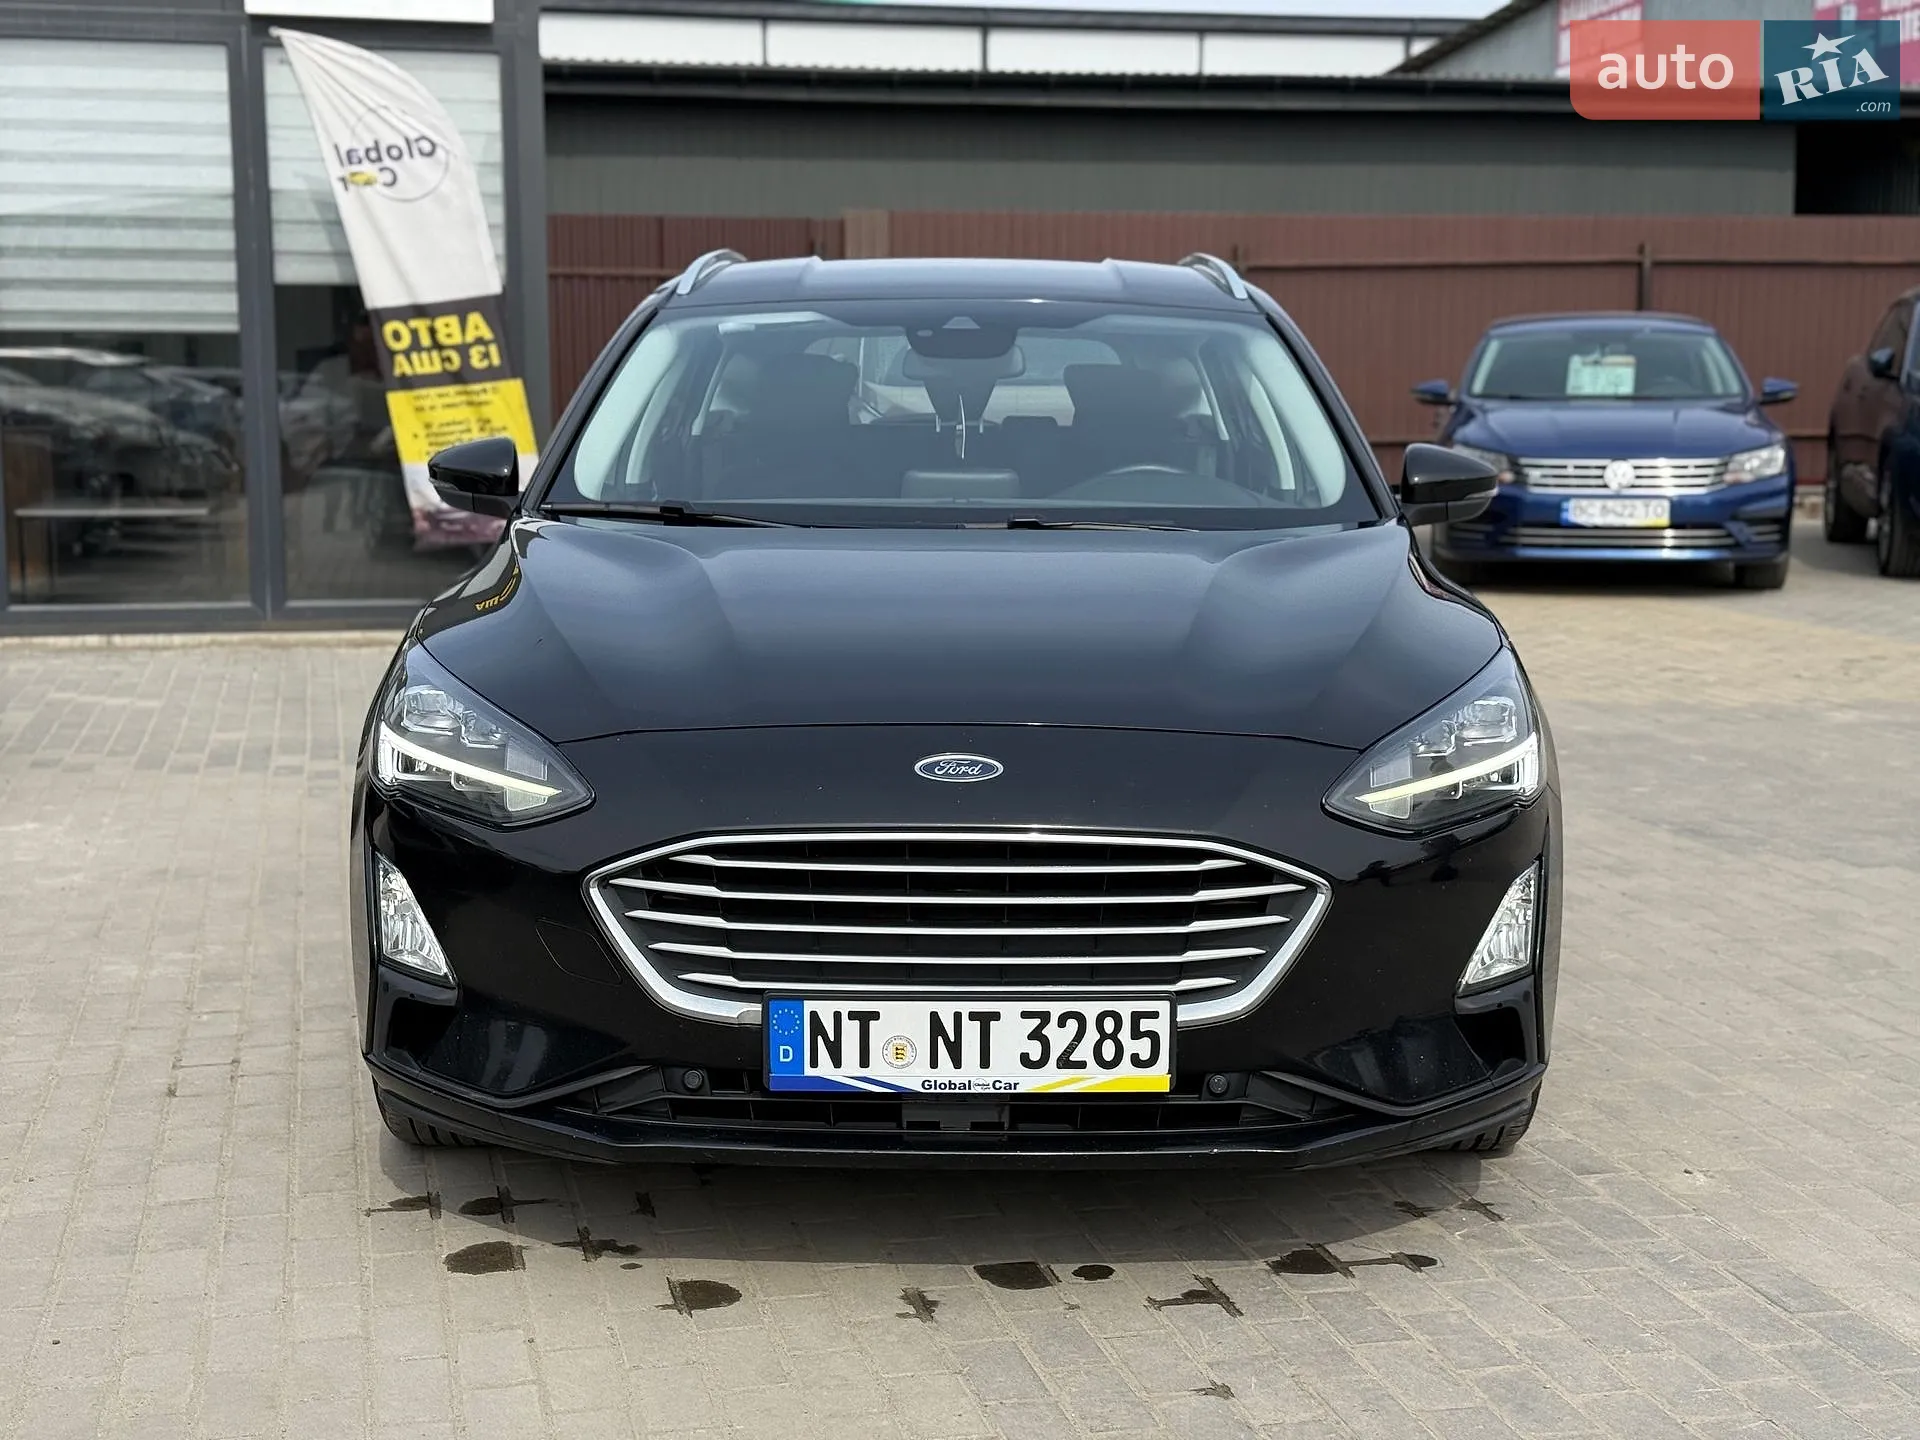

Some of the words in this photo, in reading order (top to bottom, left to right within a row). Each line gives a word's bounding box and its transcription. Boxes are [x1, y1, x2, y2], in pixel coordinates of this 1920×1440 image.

[935, 760, 983, 775] Ford
[809, 1010, 880, 1069] NT
[929, 1011, 1001, 1069] NT
[1020, 1010, 1161, 1070] 3285
[779, 1046, 793, 1062] D
[921, 1080, 972, 1091] Global
[992, 1080, 1020, 1091] Car
